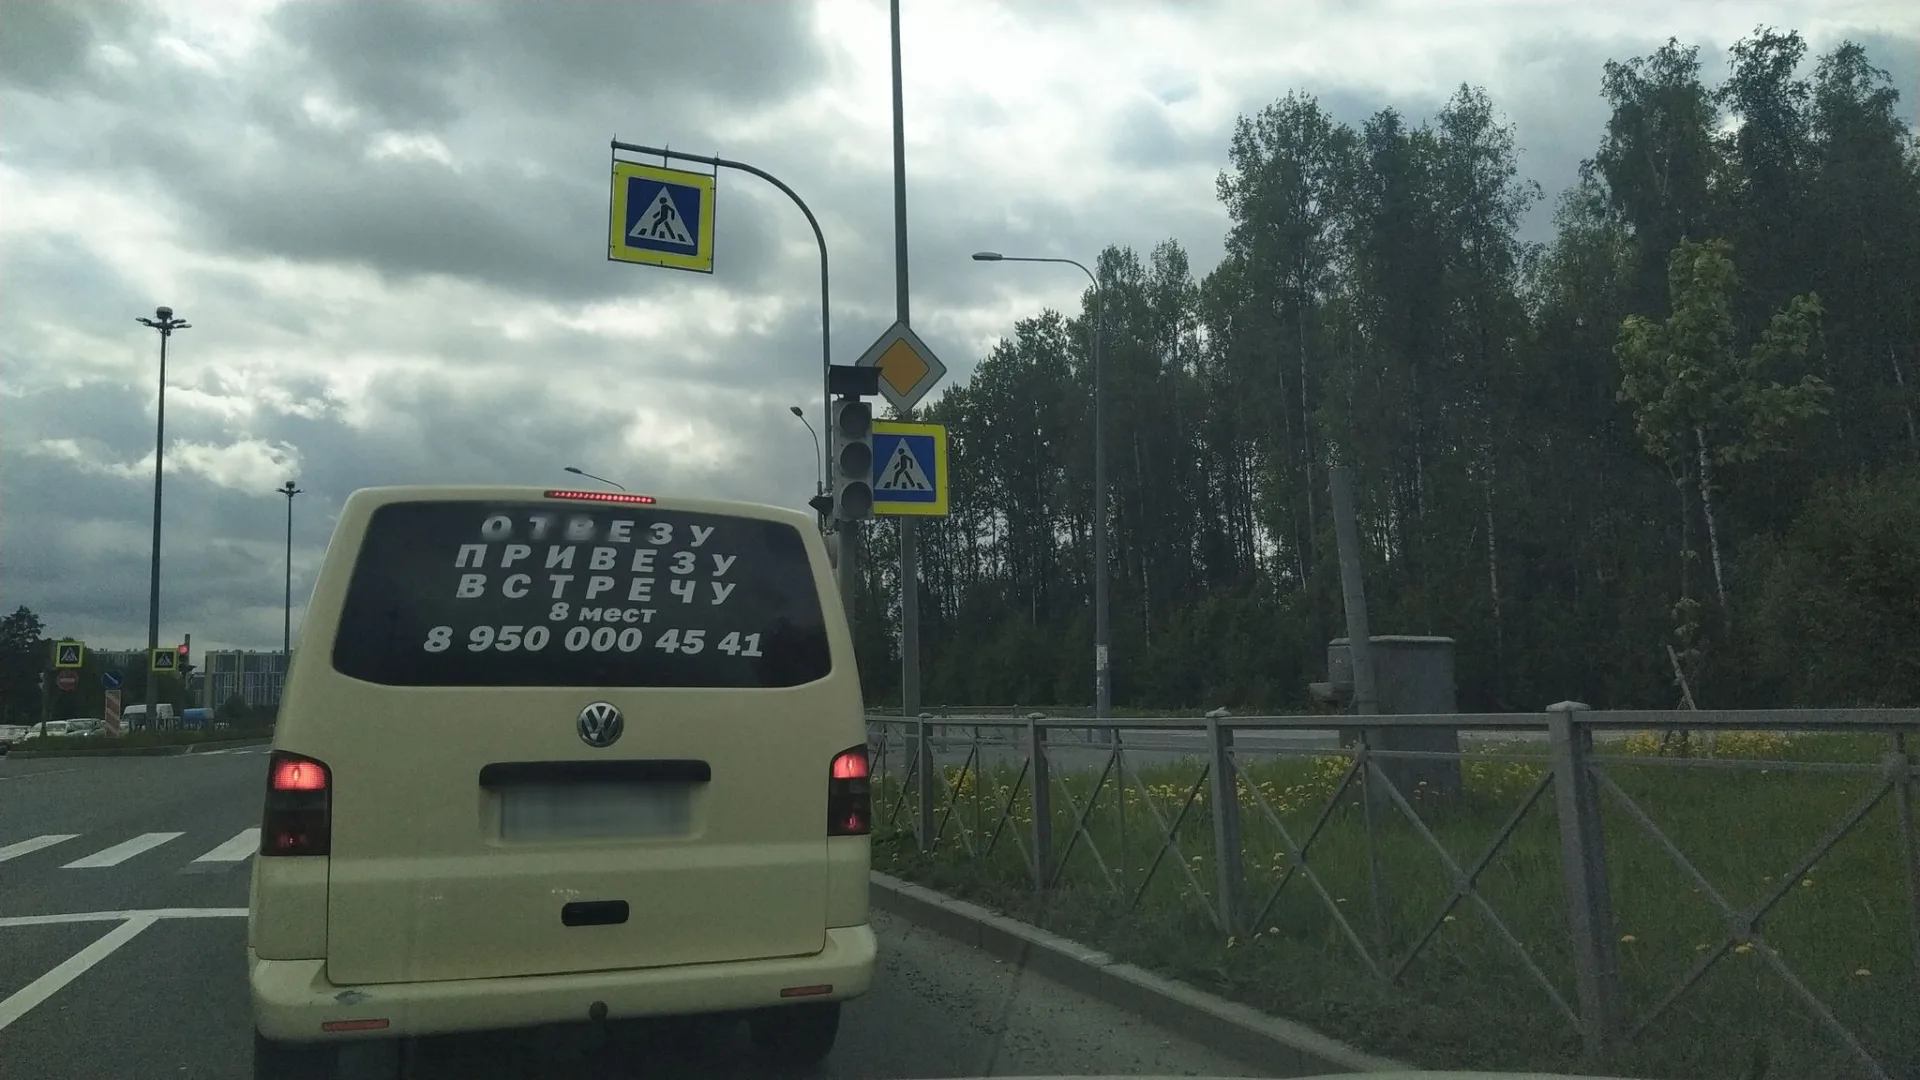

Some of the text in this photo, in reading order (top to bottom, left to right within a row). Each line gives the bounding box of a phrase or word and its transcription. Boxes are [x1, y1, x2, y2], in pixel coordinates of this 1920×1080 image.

[481, 515, 714, 547] ОТВЕЗУ
[455, 544, 737, 576] ПРИВЕЗУ
[455, 573, 736, 605] ВСТРЕЧУ
[549, 602, 657, 623] 8 мест
[423, 625, 763, 657] 8 950 000 45 41
